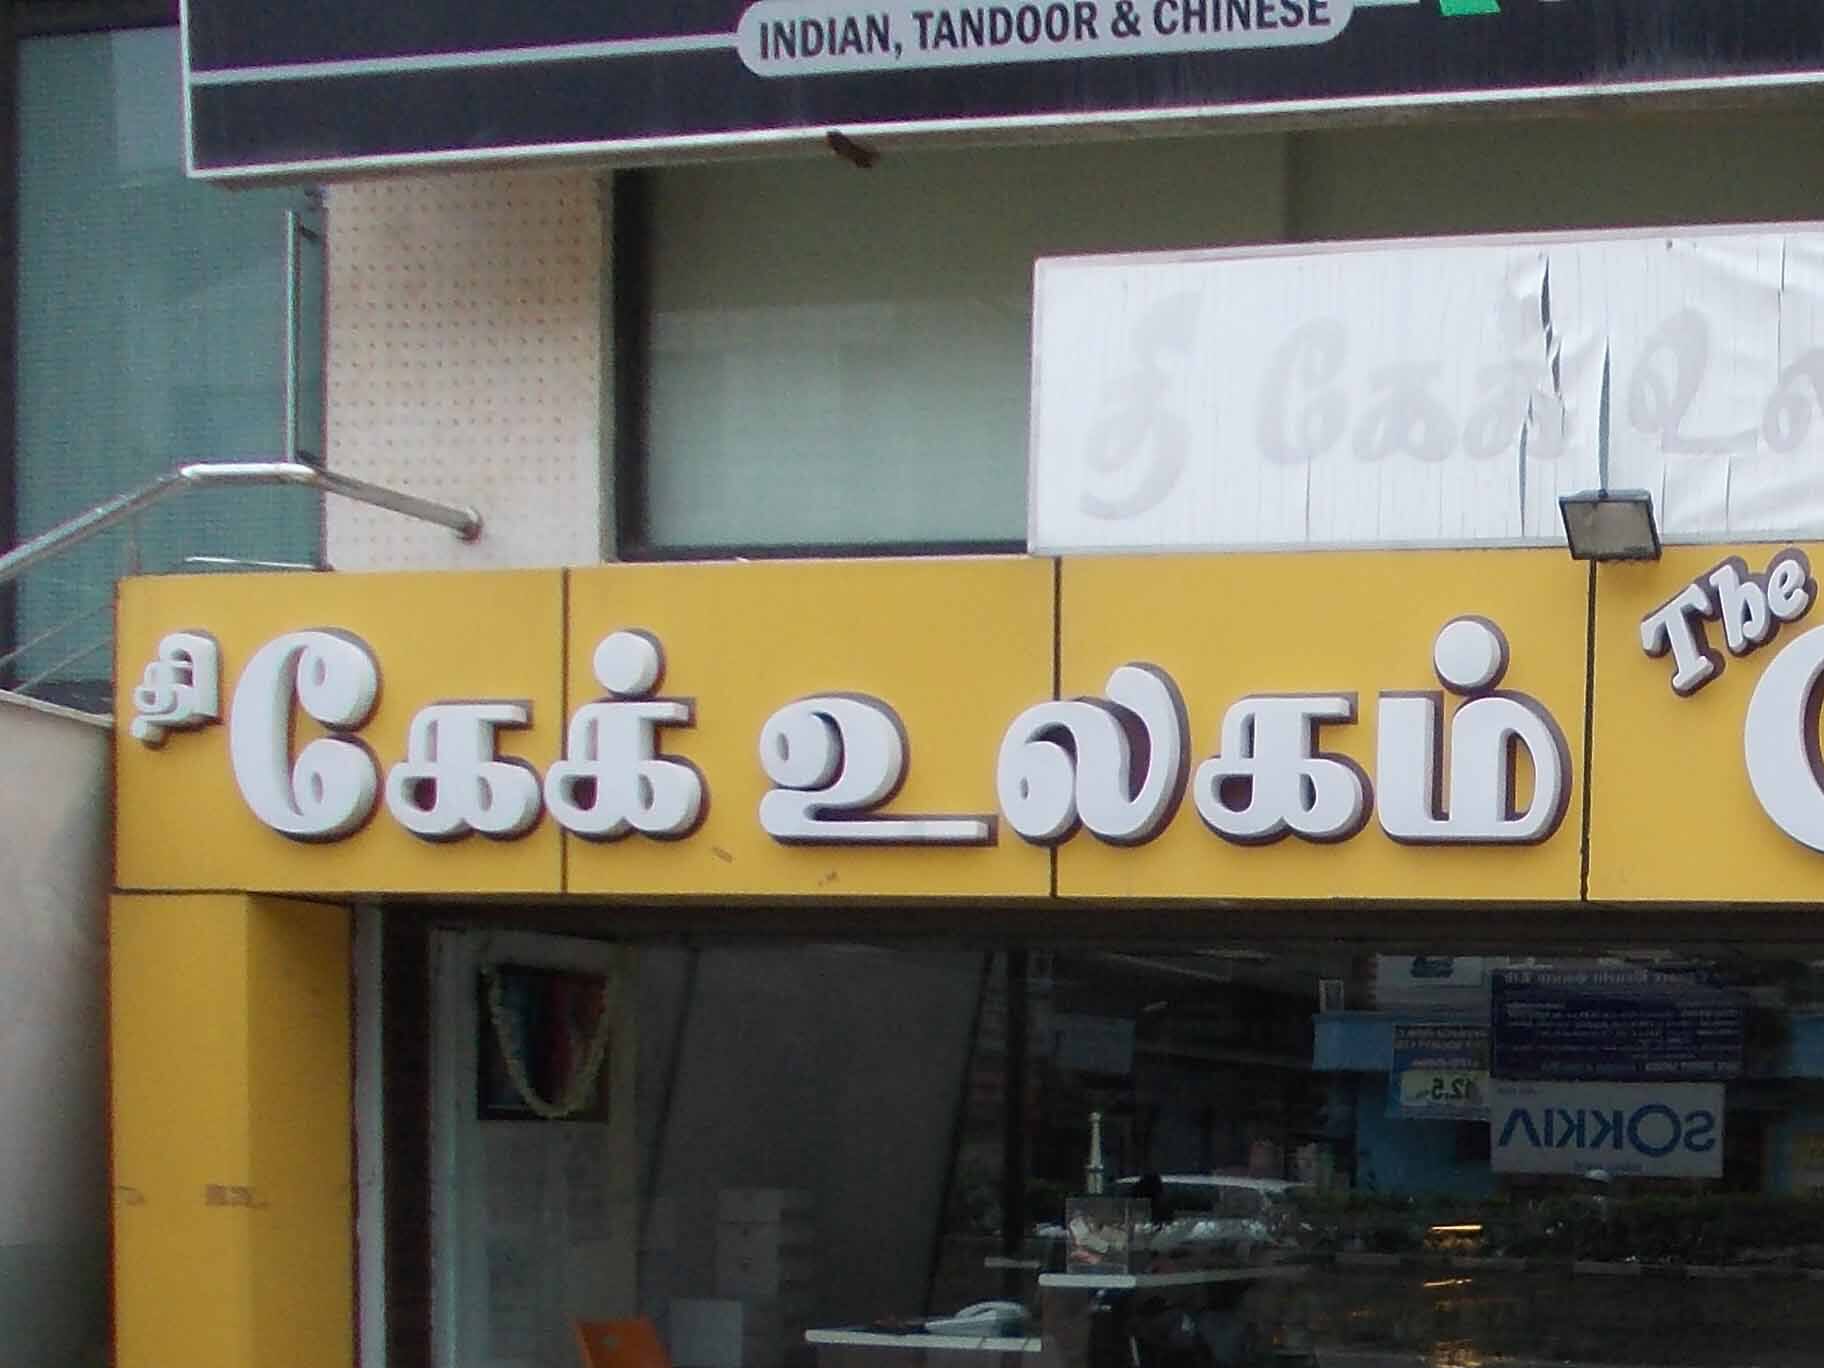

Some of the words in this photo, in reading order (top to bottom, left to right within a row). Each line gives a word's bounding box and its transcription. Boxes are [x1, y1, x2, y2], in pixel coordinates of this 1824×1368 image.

[759, 13, 903, 60] INDIAN,
[912, 1, 1098, 50] TANDOOR
[1110, 0, 1142, 38] &
[1153, 0, 1332, 35] CHINESE
[1641, 548, 1818, 697] The
[229, 628, 706, 842] கேக்
[758, 615, 1569, 845] உலகம்
